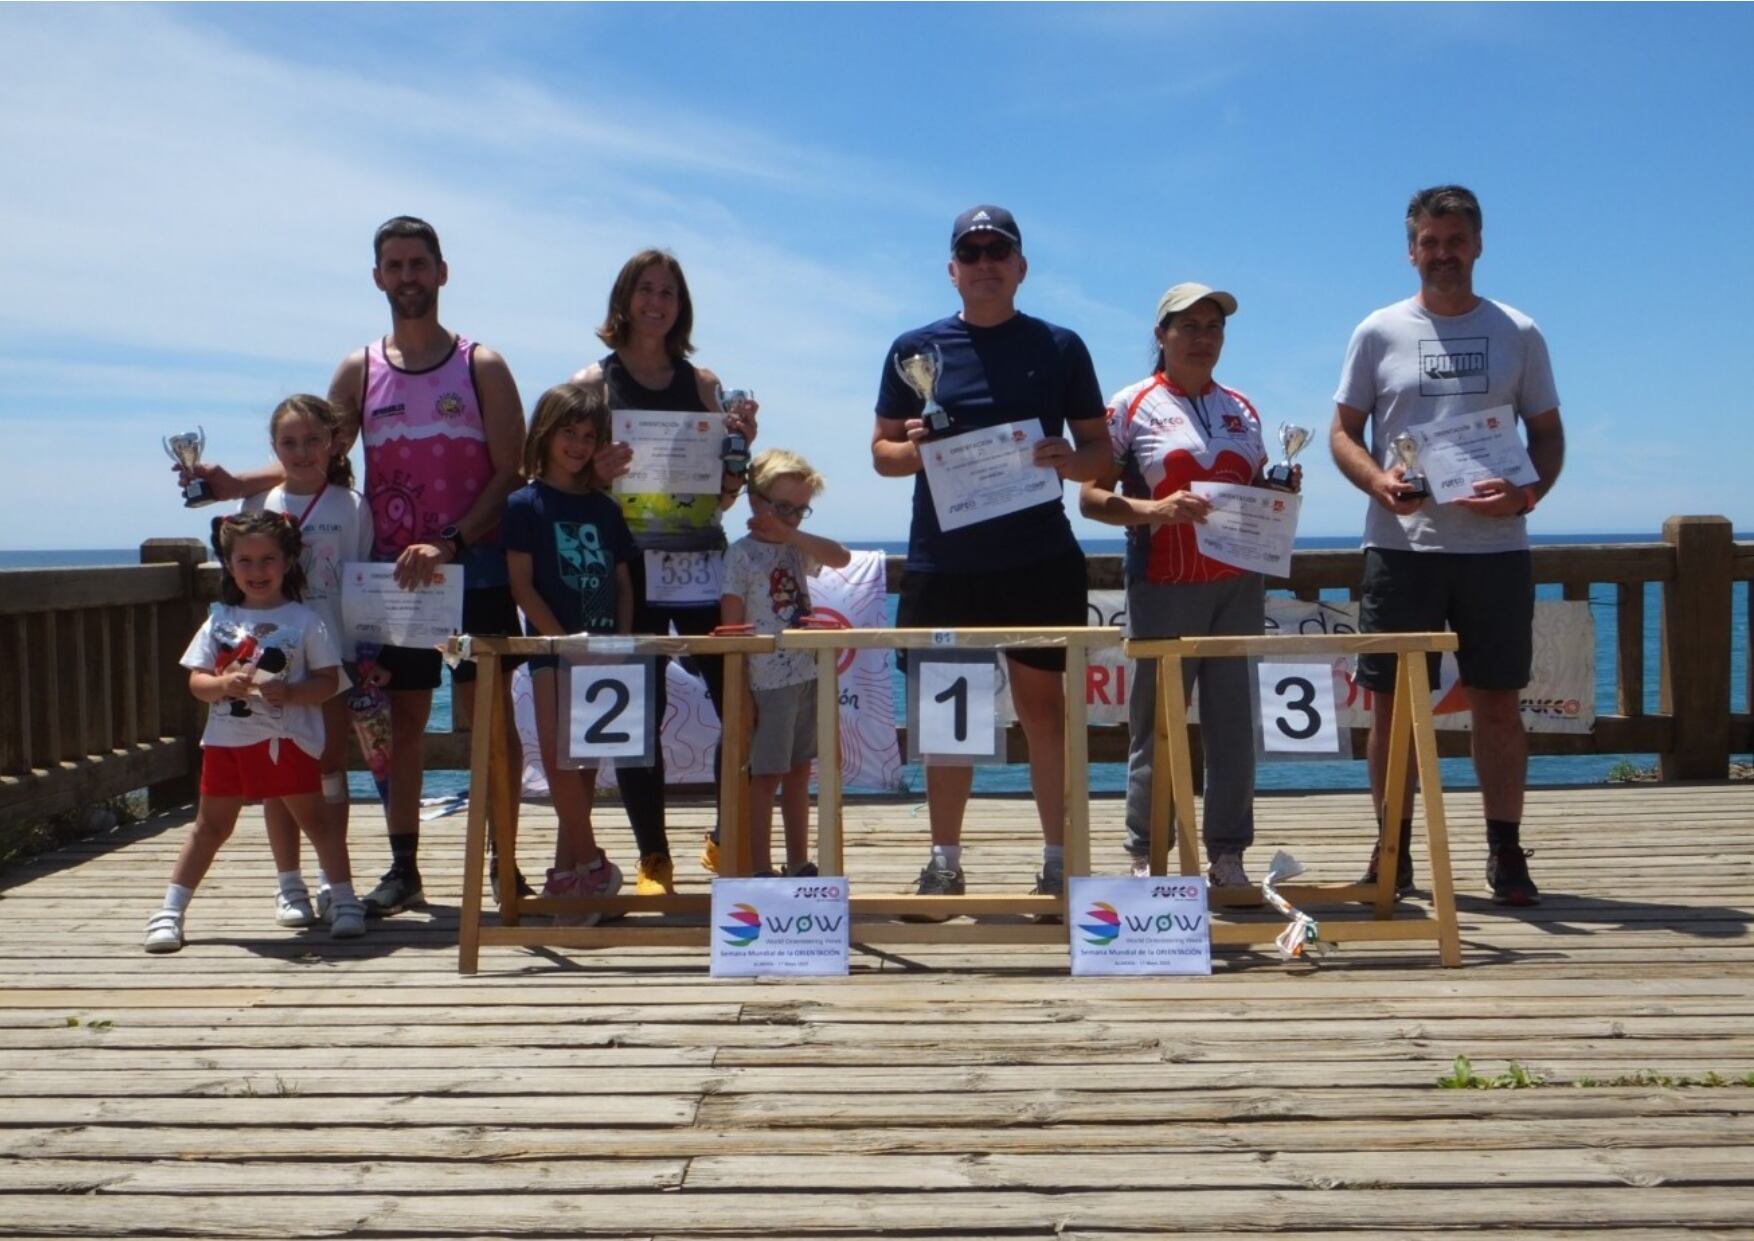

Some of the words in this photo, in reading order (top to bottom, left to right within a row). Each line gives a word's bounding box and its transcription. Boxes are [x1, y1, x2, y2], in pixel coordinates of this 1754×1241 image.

[1424, 352, 1486, 379] PUMA
[580, 577, 600, 589] TO
[661, 557, 711, 585] 533
[584, 678, 631, 744] 2
[934, 676, 968, 742] 1
[1274, 676, 1322, 740] 3
